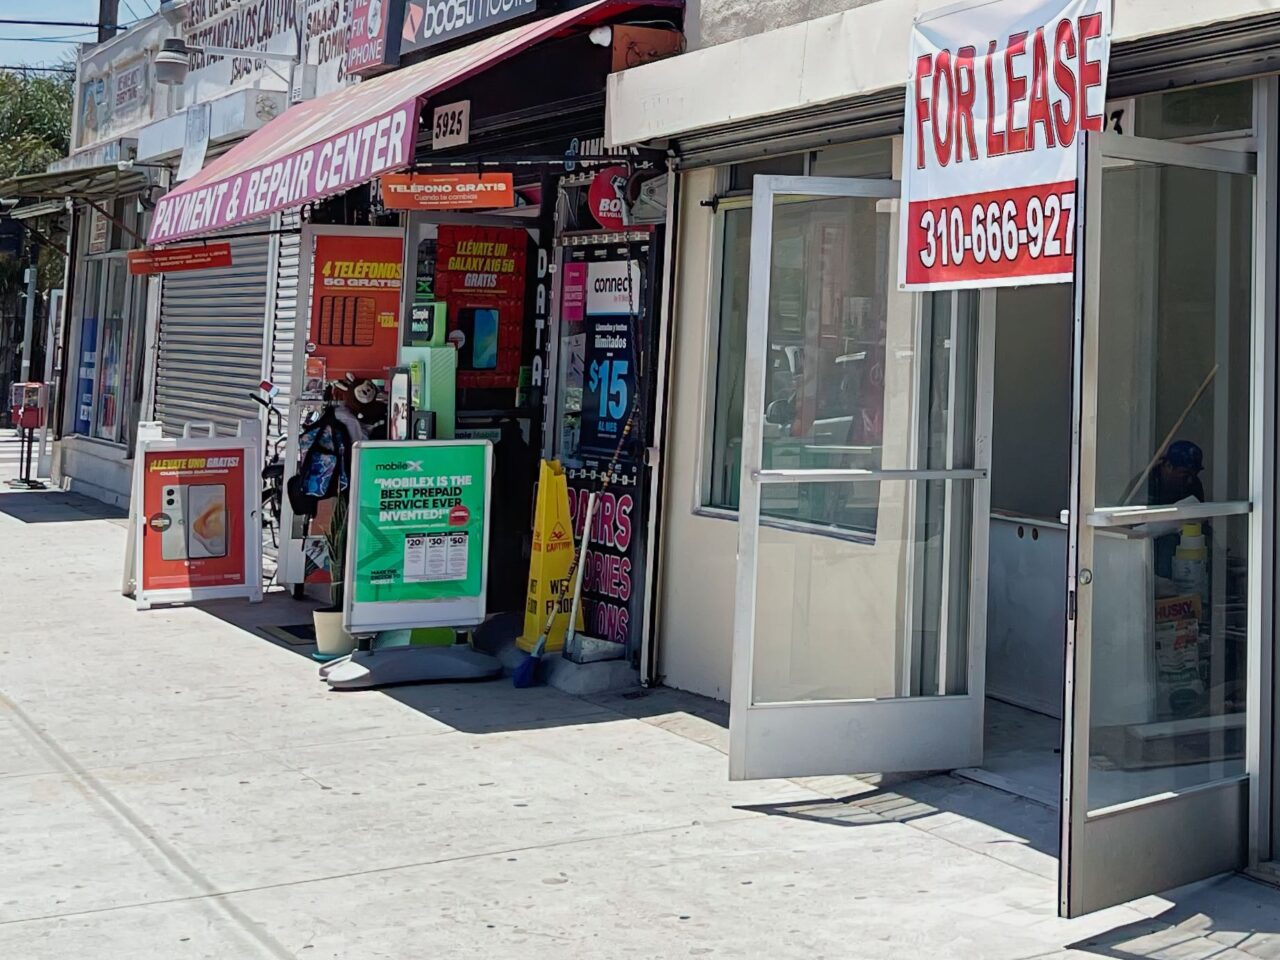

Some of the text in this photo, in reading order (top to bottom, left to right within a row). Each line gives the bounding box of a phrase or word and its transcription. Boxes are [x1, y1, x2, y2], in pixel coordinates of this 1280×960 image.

[351, 16, 366, 35] FIX
[318, 25, 352, 66] DOMING
[915, 11, 1104, 170] FOR LEASE
[435, 109, 464, 139] 5925
[150, 181, 229, 240] PAYMENT
[225, 177, 242, 222] &
[242, 149, 314, 217] REPAIR
[315, 109, 407, 193] CENTER
[388, 182, 453, 193] TELÉFONO
[455, 183, 507, 191] GRATIS
[919, 193, 1075, 269] 310-666-927
[322, 259, 403, 279] 4 TELÉFONOS
[448, 256, 485, 271] GALAXY
[501, 258, 515, 272] 5G
[347, 278, 401, 288] GRATIS
[464, 273, 498, 288] GRATIS
[594, 277, 633, 293] connec
[531, 248, 548, 387] DATA
[588, 359, 629, 420] $15
[376, 460, 424, 471] mobileX
[437, 476, 448, 487] IS
[450, 475, 472, 486] THE
[381, 487, 463, 500] BEST PREPAID
[380, 498, 463, 512] SERVICE EVER
[1156, 600, 1193, 619] HUSKY
